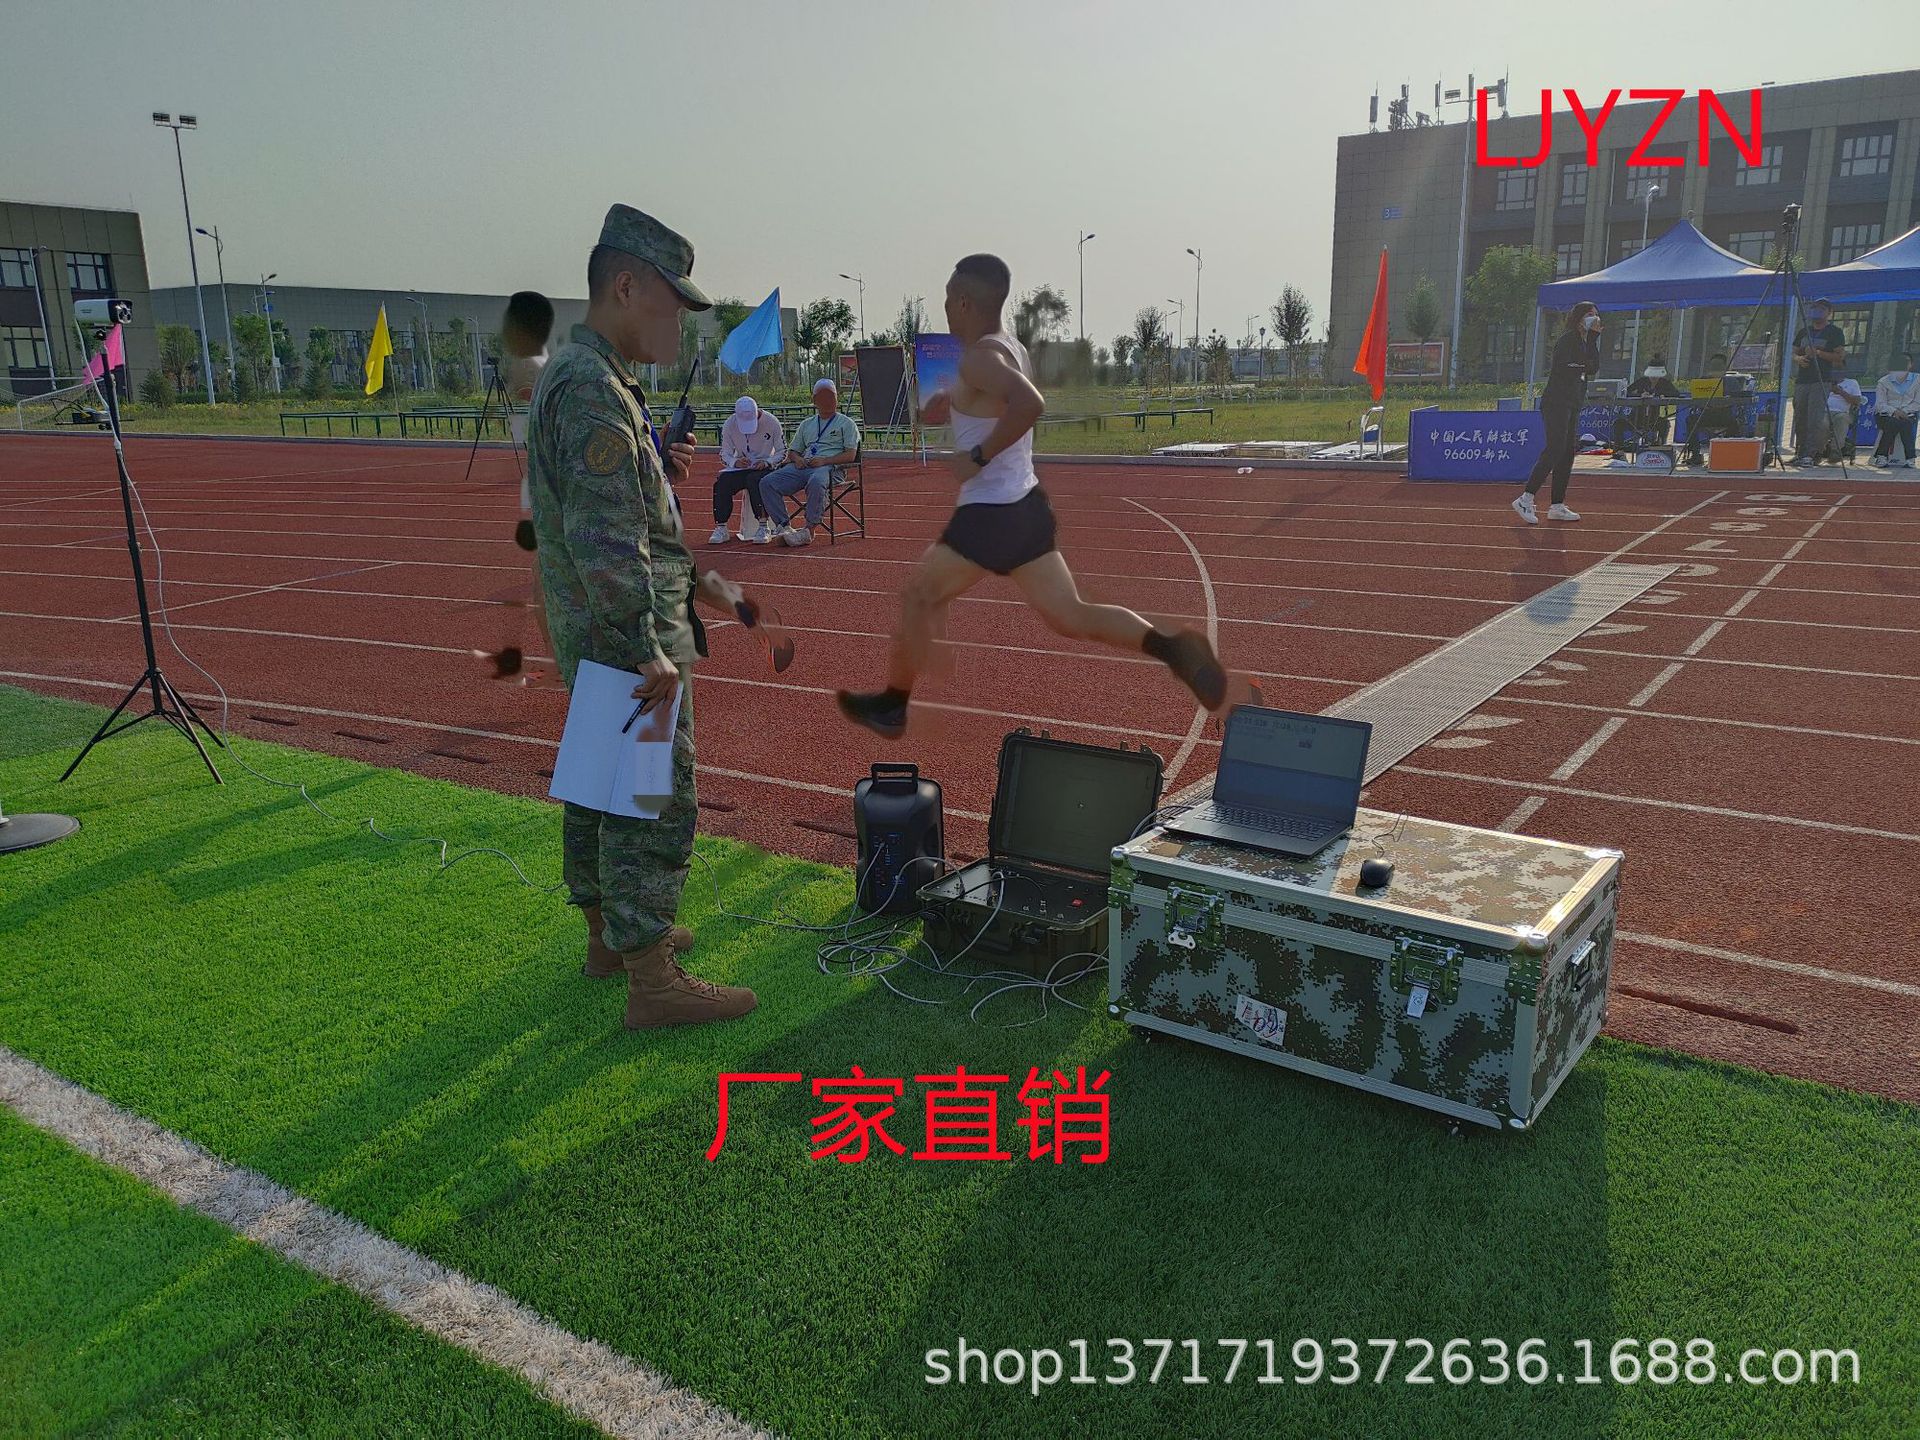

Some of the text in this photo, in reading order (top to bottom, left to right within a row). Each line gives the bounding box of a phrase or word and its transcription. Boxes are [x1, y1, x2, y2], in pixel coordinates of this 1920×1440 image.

[1430, 428, 1529, 446] 中国人民解放军
[1444, 447, 1510, 462] 96609部队
